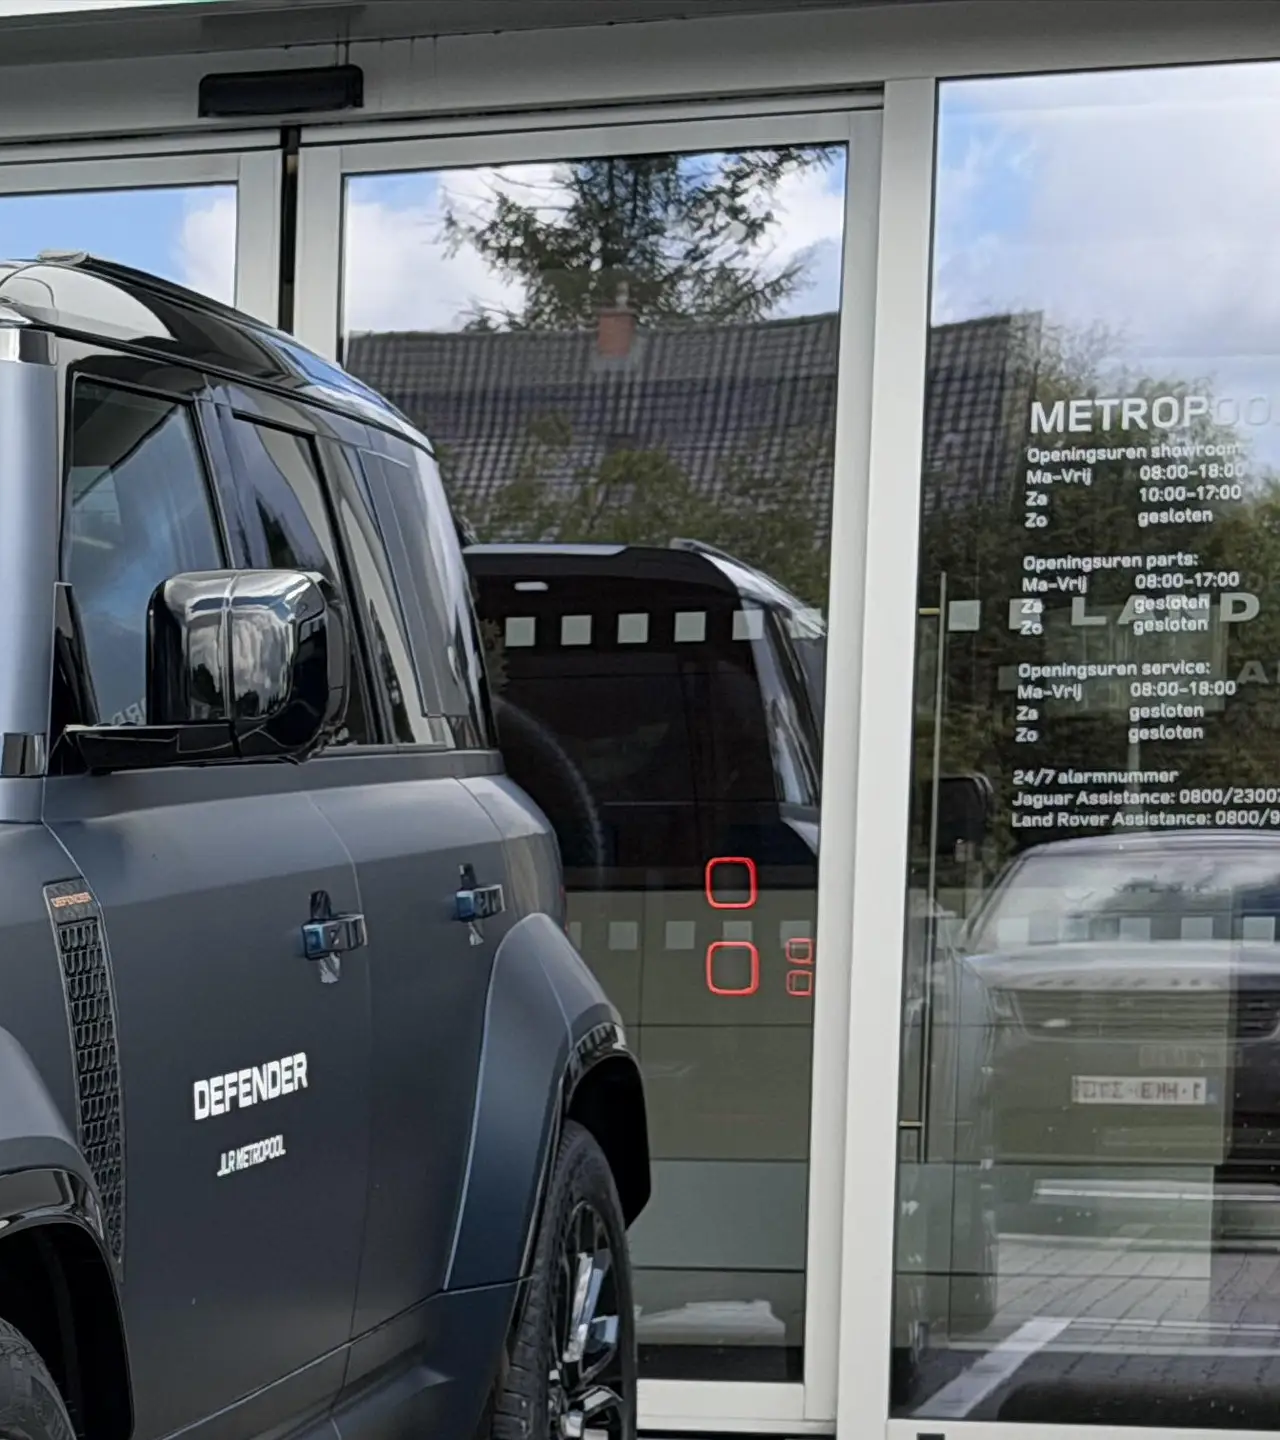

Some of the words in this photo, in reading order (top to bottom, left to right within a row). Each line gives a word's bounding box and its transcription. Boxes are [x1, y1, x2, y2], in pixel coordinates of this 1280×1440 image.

[1027, 446, 1148, 466] Openingsuren
[1026, 467, 1092, 486] Ma-Vrij
[1140, 462, 1245, 481] 08:00-18:00
[1025, 491, 1049, 507] Za
[1140, 485, 1242, 503] 10:00-17:00
[1025, 512, 1048, 528] Zo
[1137, 507, 1214, 528] gesloten
[1023, 554, 1143, 574] Openingsuren
[1146, 551, 1199, 571] parts:
[1022, 575, 1088, 594] Ma-Vrij
[1135, 571, 1240, 589] 08:00-17:00
[1021, 598, 1043, 614] Za
[1133, 594, 1210, 614] gesloten
[1020, 620, 1043, 635] Zo
[1133, 617, 1209, 636] gesloten
[1018, 662, 1138, 681] Openingsuren
[1142, 659, 1211, 676] service:
[1017, 683, 1083, 701] Ma-Vrij
[1130, 680, 1237, 698] 08:00-18:00
[1016, 705, 1039, 721] Za
[1129, 703, 1205, 722] gesloten
[1015, 727, 1038, 742] Zo
[1128, 724, 1204, 744] gesloten
[1012, 768, 1055, 786] 24/7
[1057, 768, 1180, 784] alarmnummer
[1012, 791, 1074, 810] Jaguar
[1076, 789, 1176, 806] Assistance:
[1011, 812, 1054, 828] Land
[1057, 812, 1109, 828] Rover
[1112, 810, 1212, 827] Assistance:
[193, 1051, 309, 1121] DEFENDER
[236, 1133, 287, 1171] METROPOOL
